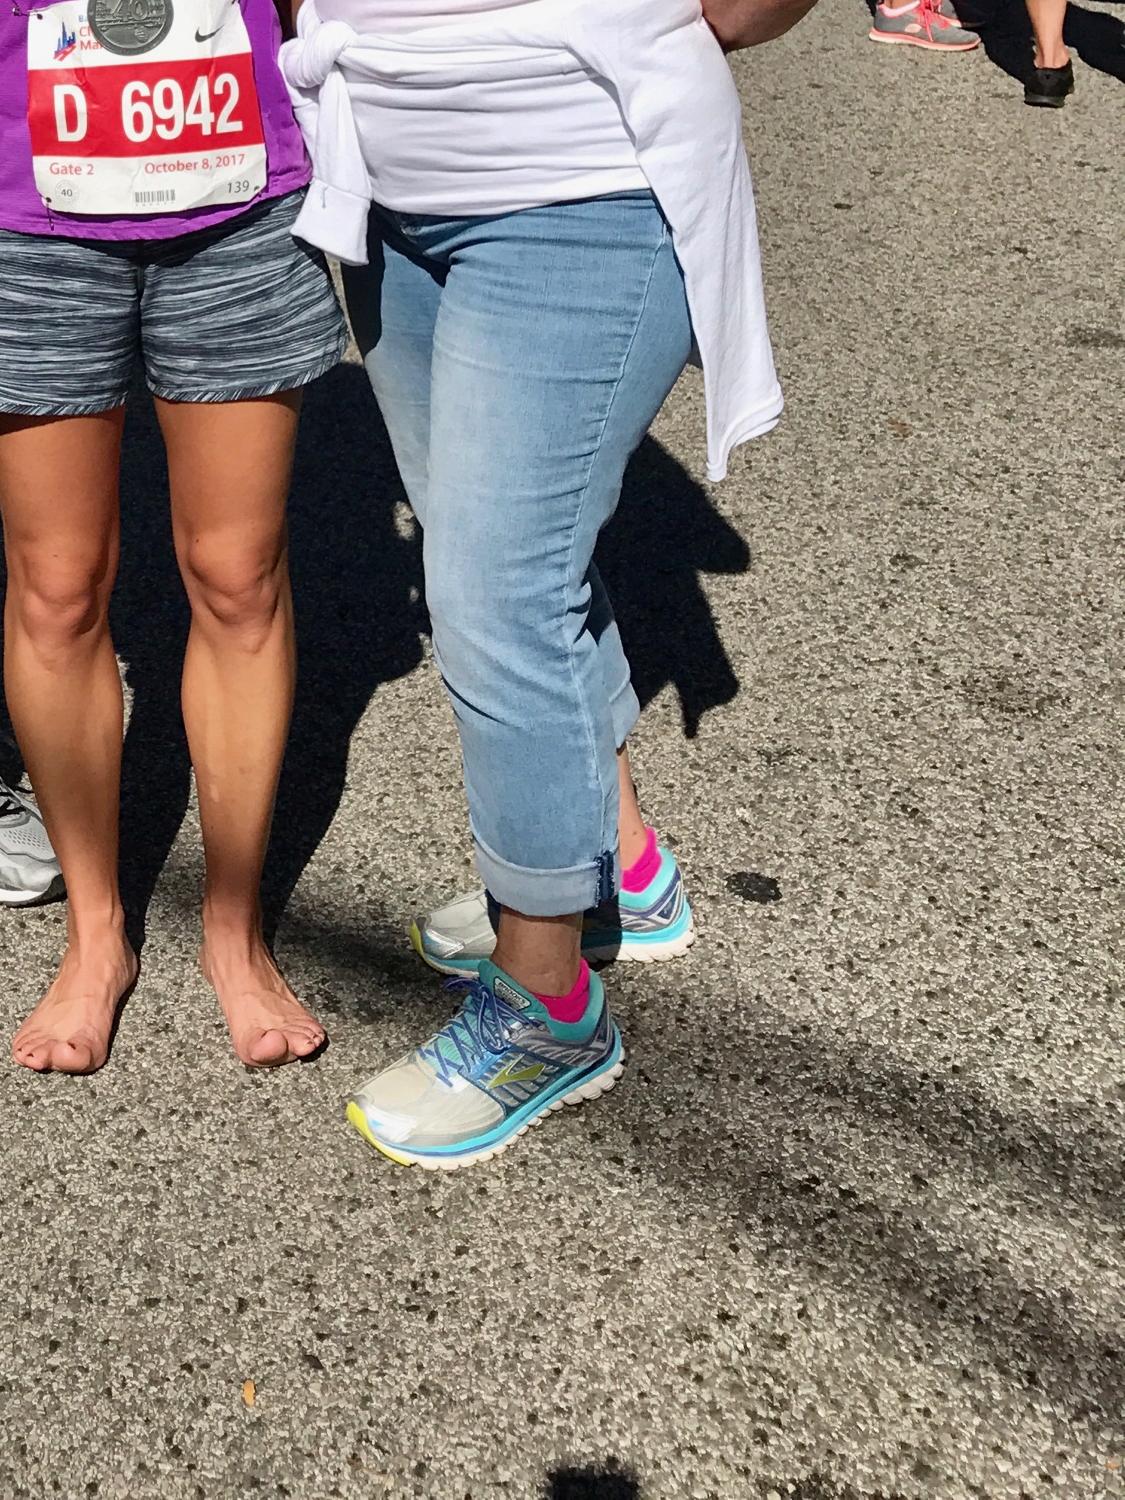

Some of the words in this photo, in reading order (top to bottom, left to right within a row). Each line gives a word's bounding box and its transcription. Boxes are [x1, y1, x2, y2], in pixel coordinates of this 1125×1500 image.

[53, 84, 87, 142] D
[121, 72, 244, 143] 6942
[49, 162, 82, 176] Gate
[86, 163, 94, 175] 2
[144, 159, 198, 174] October
[201, 158, 212, 171] 8,
[215, 153, 246, 167] 2017
[60, 188, 73, 197] 40
[227, 180, 250, 194] 139
